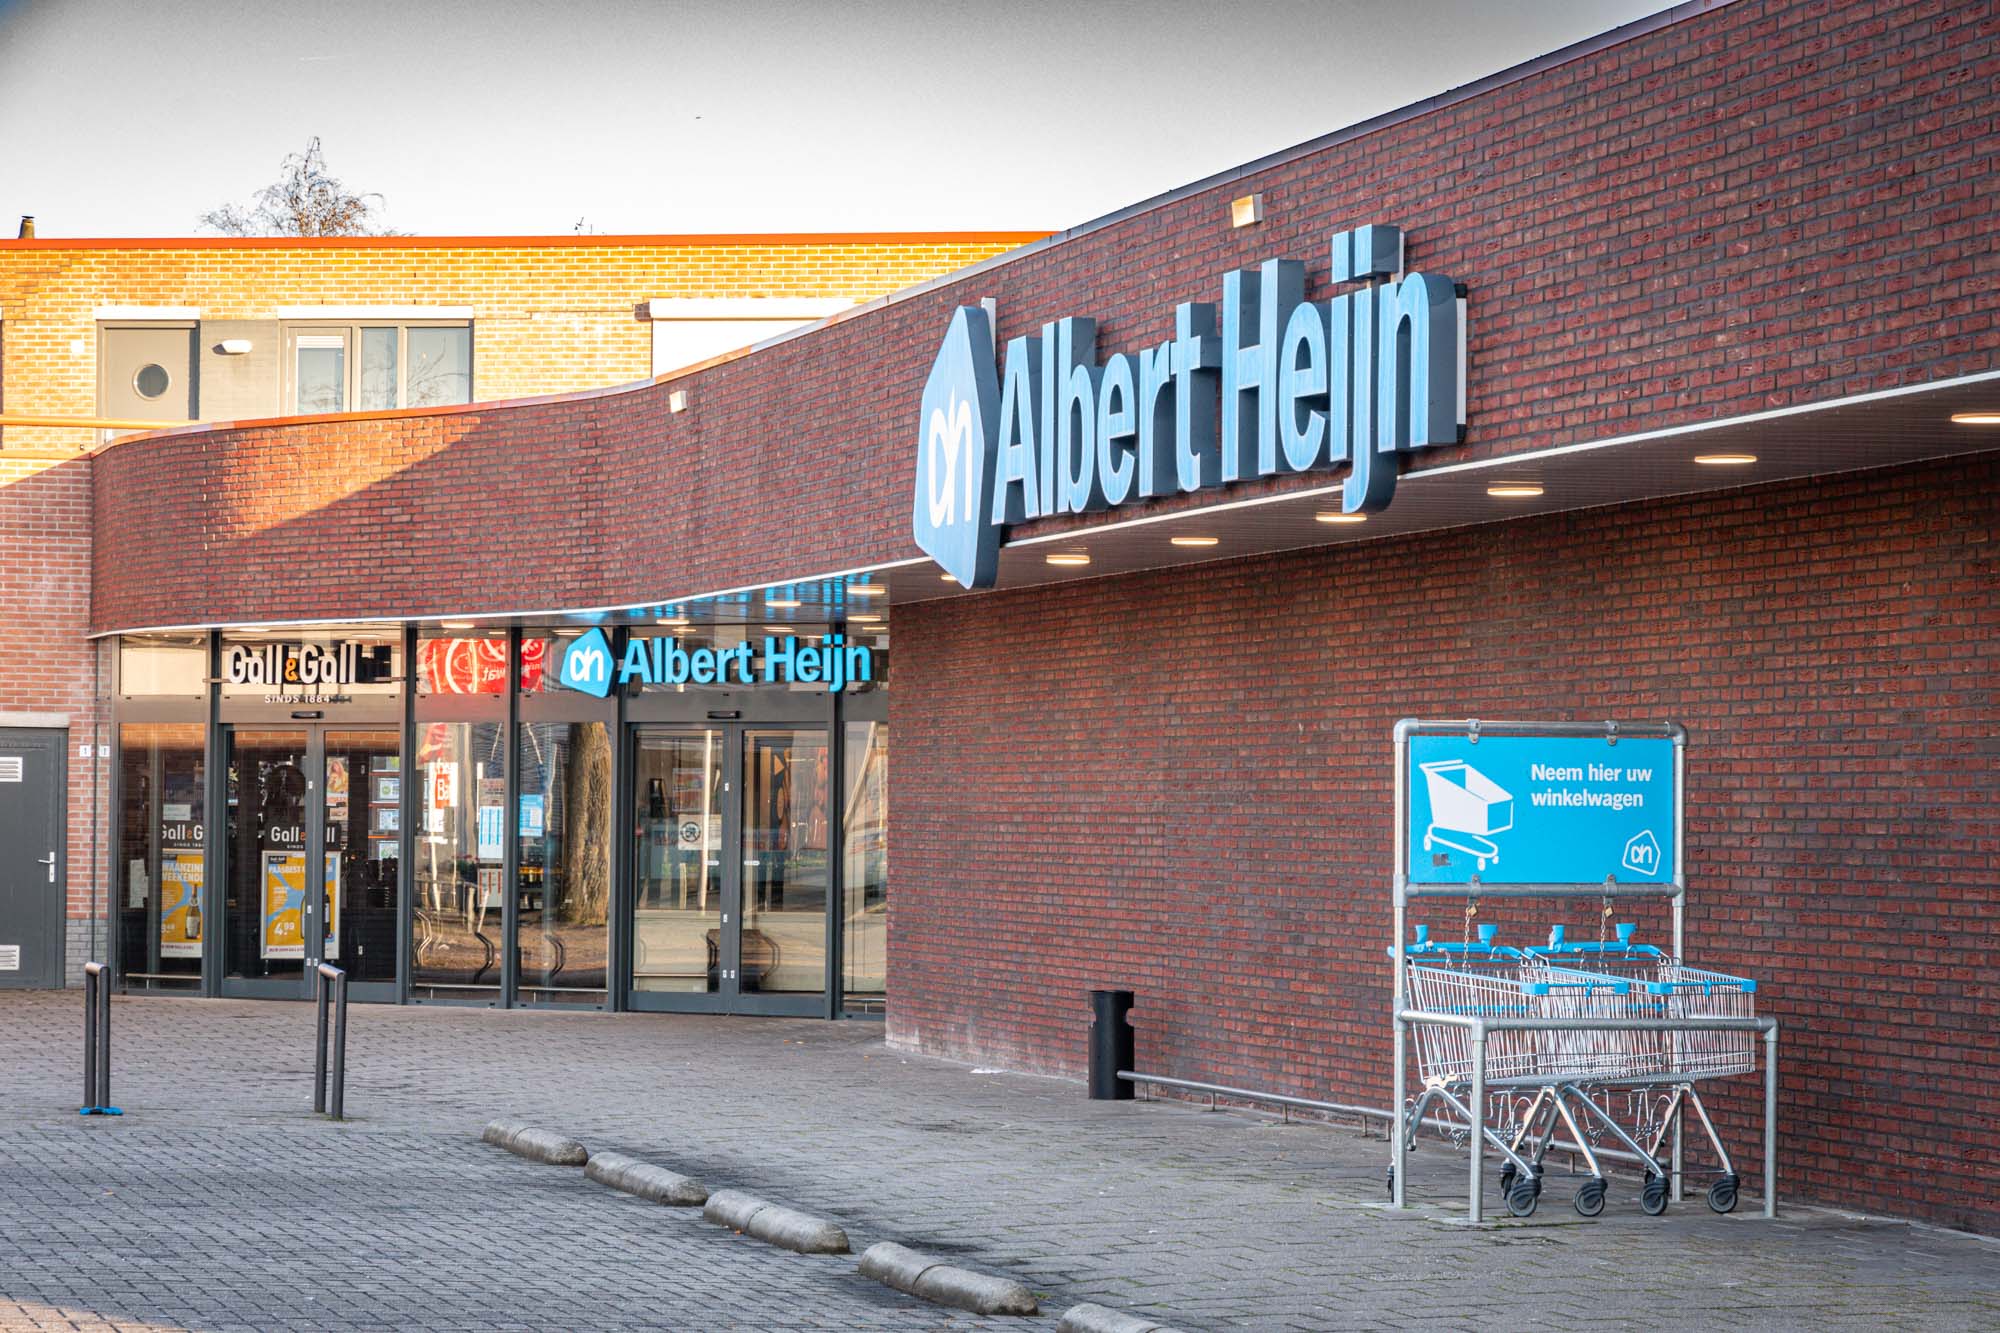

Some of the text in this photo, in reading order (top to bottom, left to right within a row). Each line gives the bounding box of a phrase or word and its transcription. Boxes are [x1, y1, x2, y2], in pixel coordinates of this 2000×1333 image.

[992, 224, 1430, 526] Albert Heijn
[619, 634, 871, 693] Albert Heijn
[264, 694, 331, 703] SINDS 1884
[1531, 763, 1653, 782] Neem hier uw
[1531, 788, 1644, 811] winkelwagen
